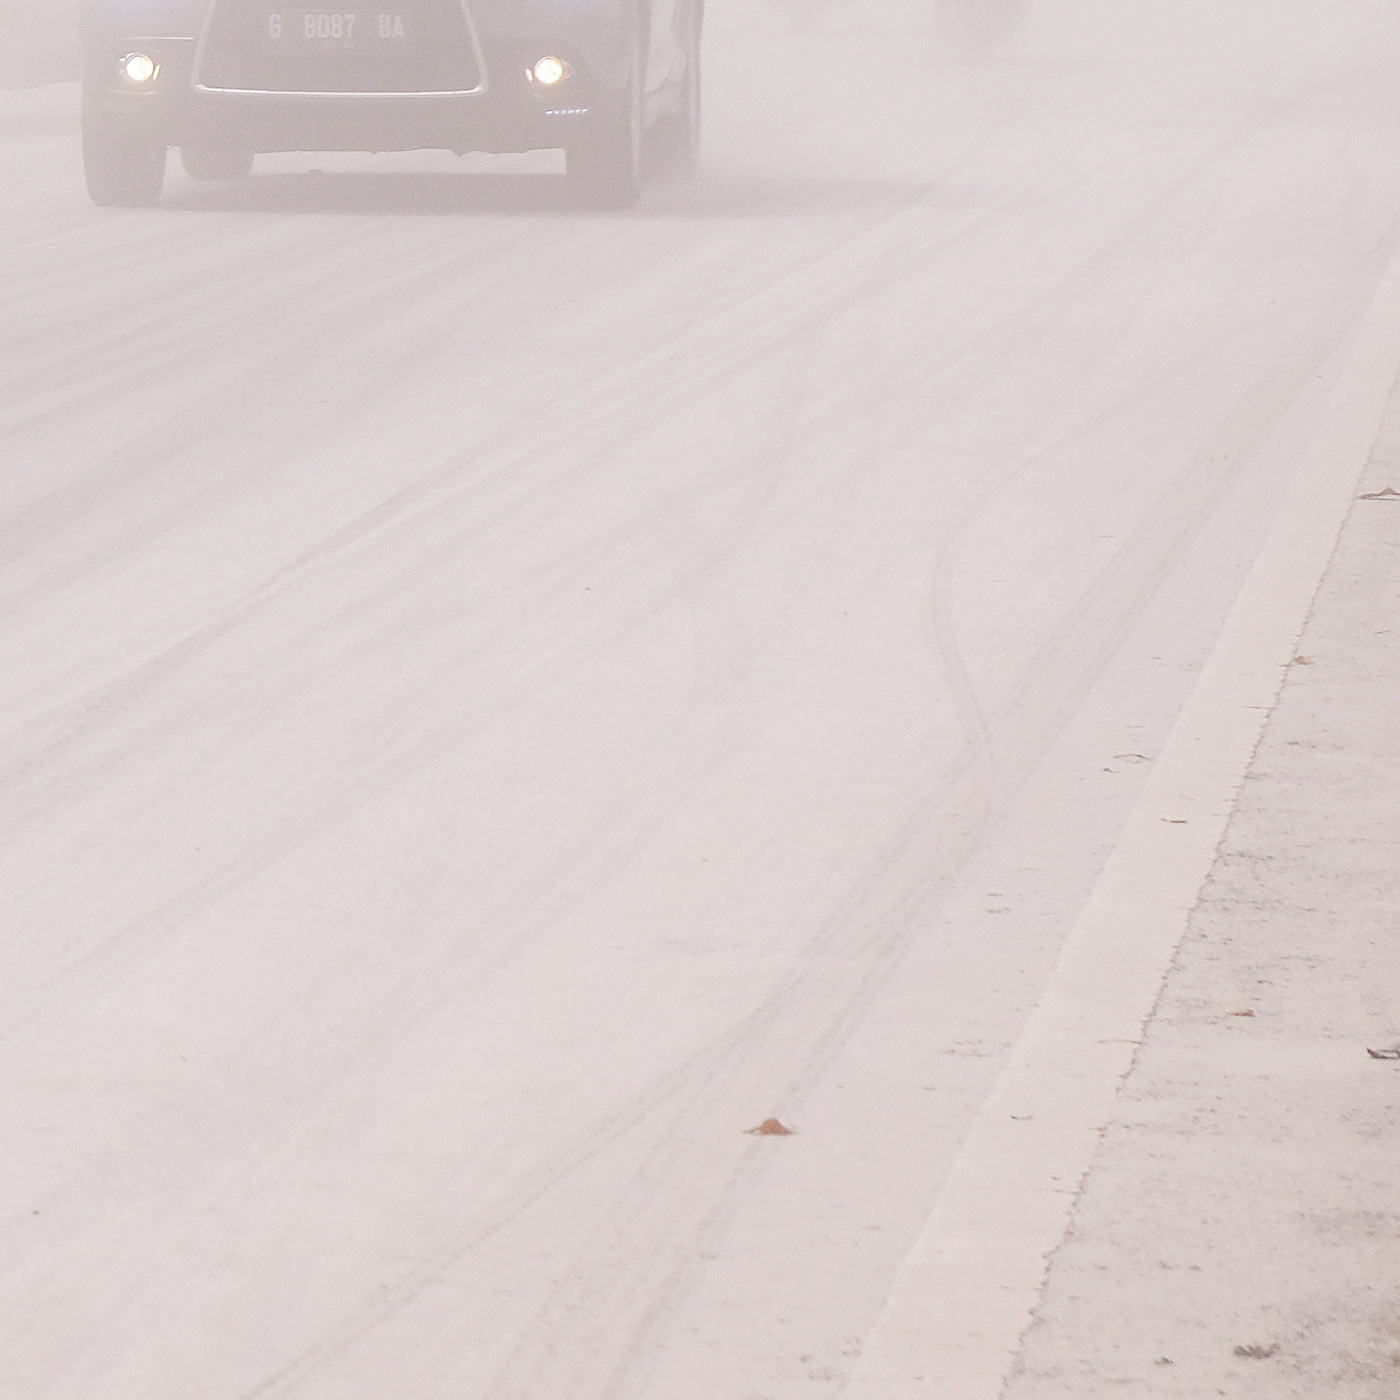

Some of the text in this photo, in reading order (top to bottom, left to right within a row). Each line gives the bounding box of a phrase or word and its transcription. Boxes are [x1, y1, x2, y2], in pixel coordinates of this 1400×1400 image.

[268, 13, 405, 39] G 8087 BA
